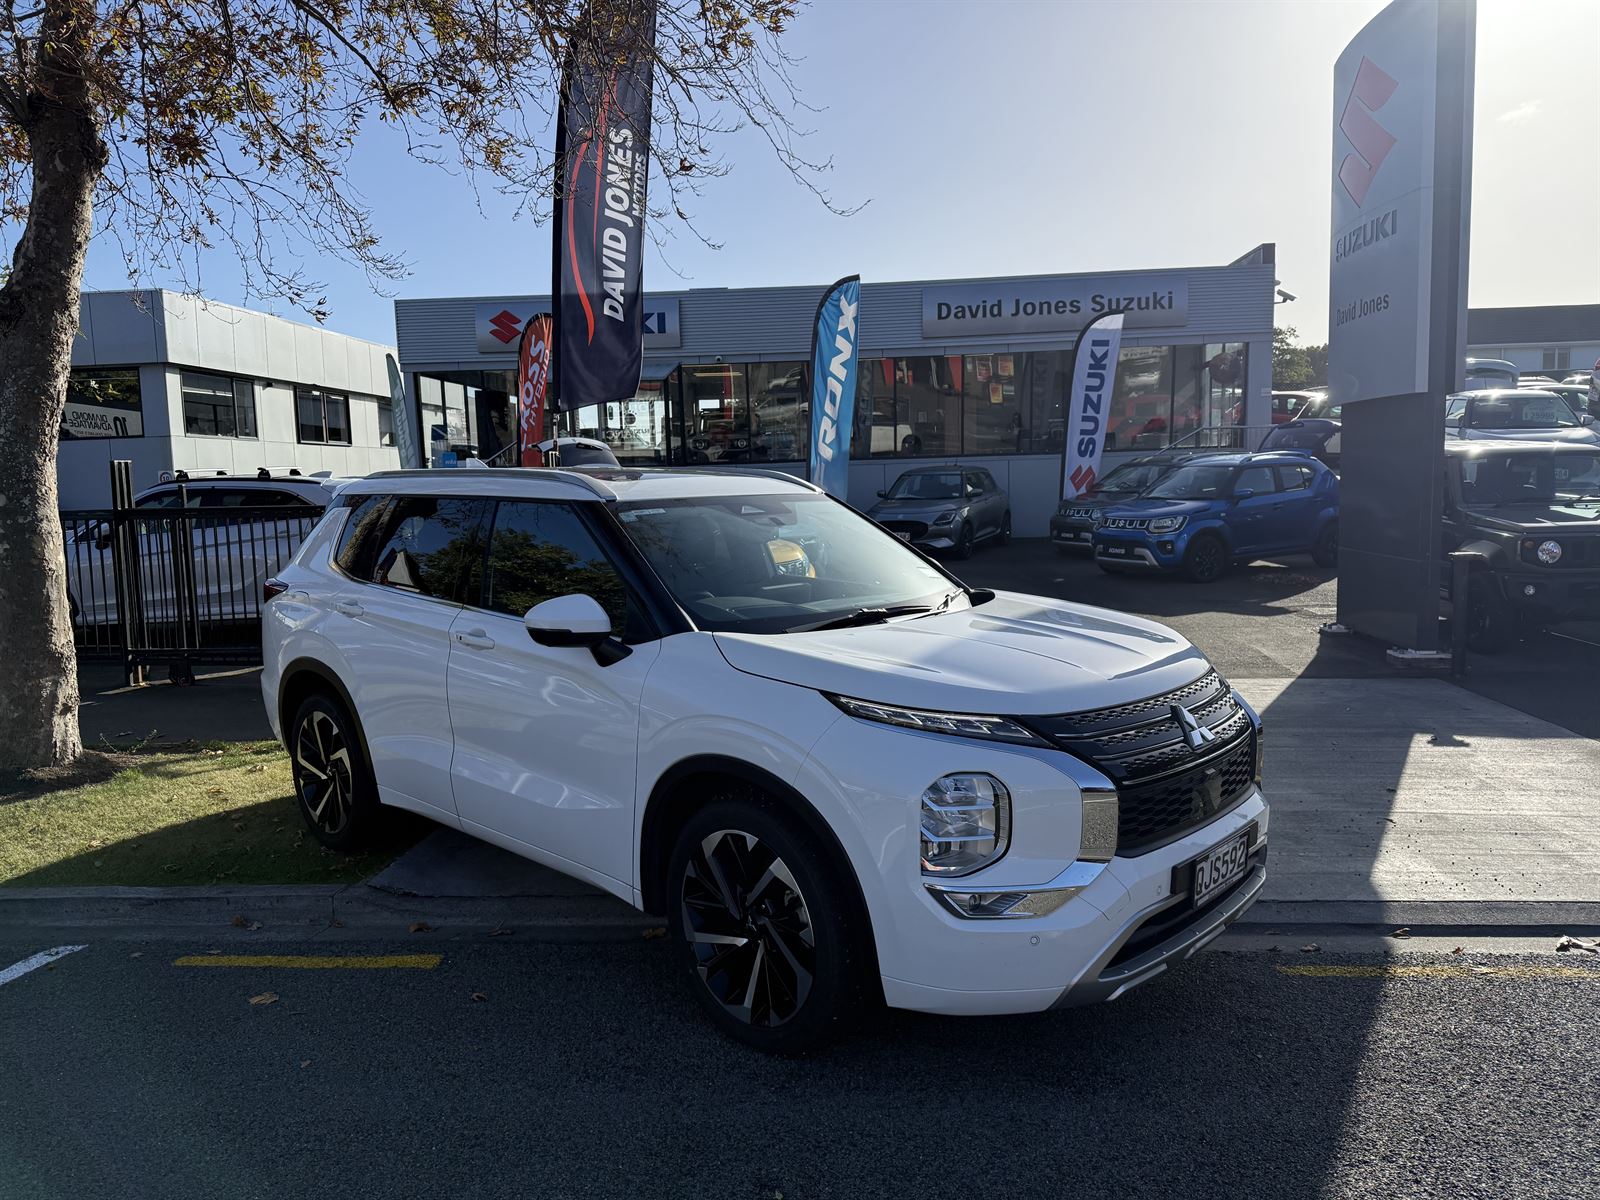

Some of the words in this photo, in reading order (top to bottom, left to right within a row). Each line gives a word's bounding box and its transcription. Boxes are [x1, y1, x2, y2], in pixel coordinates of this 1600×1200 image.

[604, 126, 634, 228] JONES
[631, 152, 647, 218] MOTORS
[1336, 209, 1398, 263] SUZUKI
[602, 227, 627, 323] DAVID
[936, 299, 1002, 321] David
[1010, 297, 1081, 317] Jones
[1090, 291, 1174, 313] Suzuki
[1336, 300, 1357, 327] David
[1358, 294, 1390, 319] Jones
[529, 349, 550, 426] HYBRID
[1077, 339, 1109, 459] SUZUKI
[1196, 839, 1245, 896] QJS592
